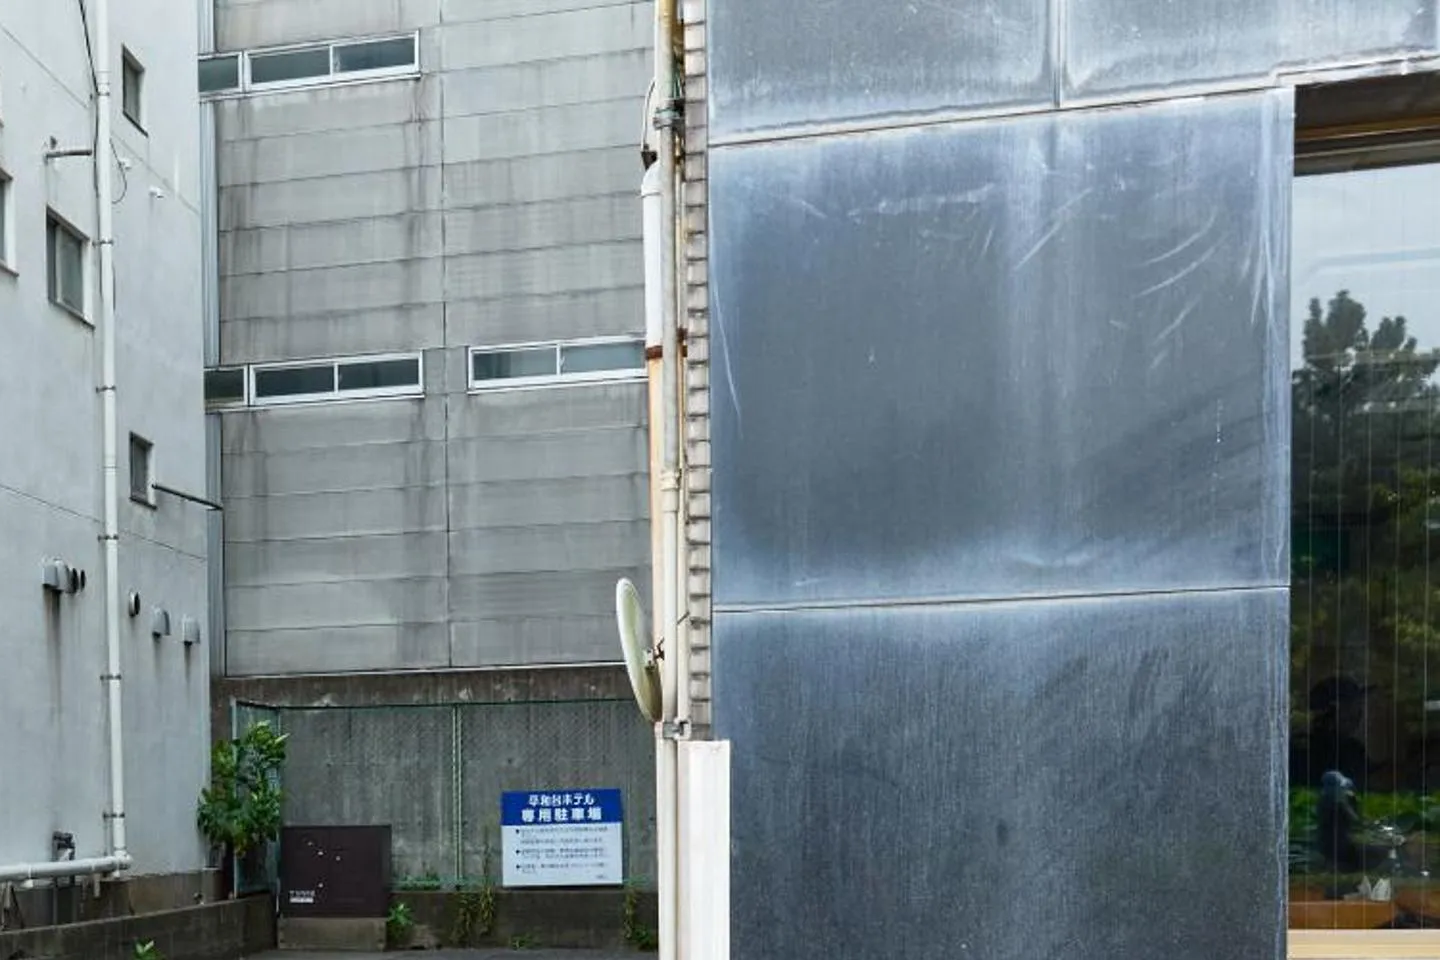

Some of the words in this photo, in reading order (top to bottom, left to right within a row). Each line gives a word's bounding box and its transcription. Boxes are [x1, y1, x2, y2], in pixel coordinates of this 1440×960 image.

[522, 807, 601, 822] 専用駐車場
